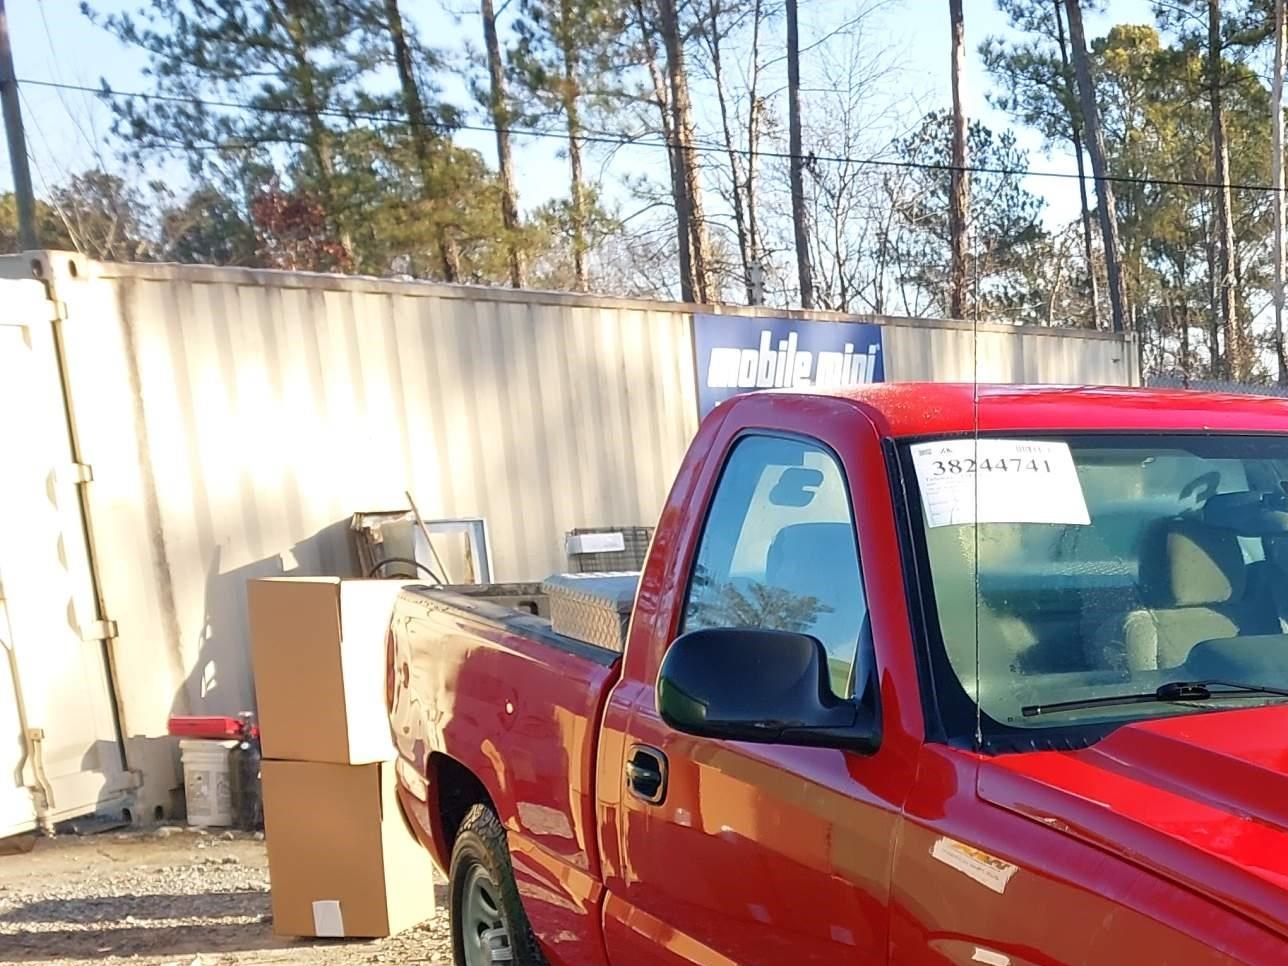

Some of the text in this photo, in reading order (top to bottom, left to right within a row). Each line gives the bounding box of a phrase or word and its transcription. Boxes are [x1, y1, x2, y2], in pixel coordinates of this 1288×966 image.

[708, 331, 877, 388] mobile mini
[932, 458, 1050, 476] 38244741
